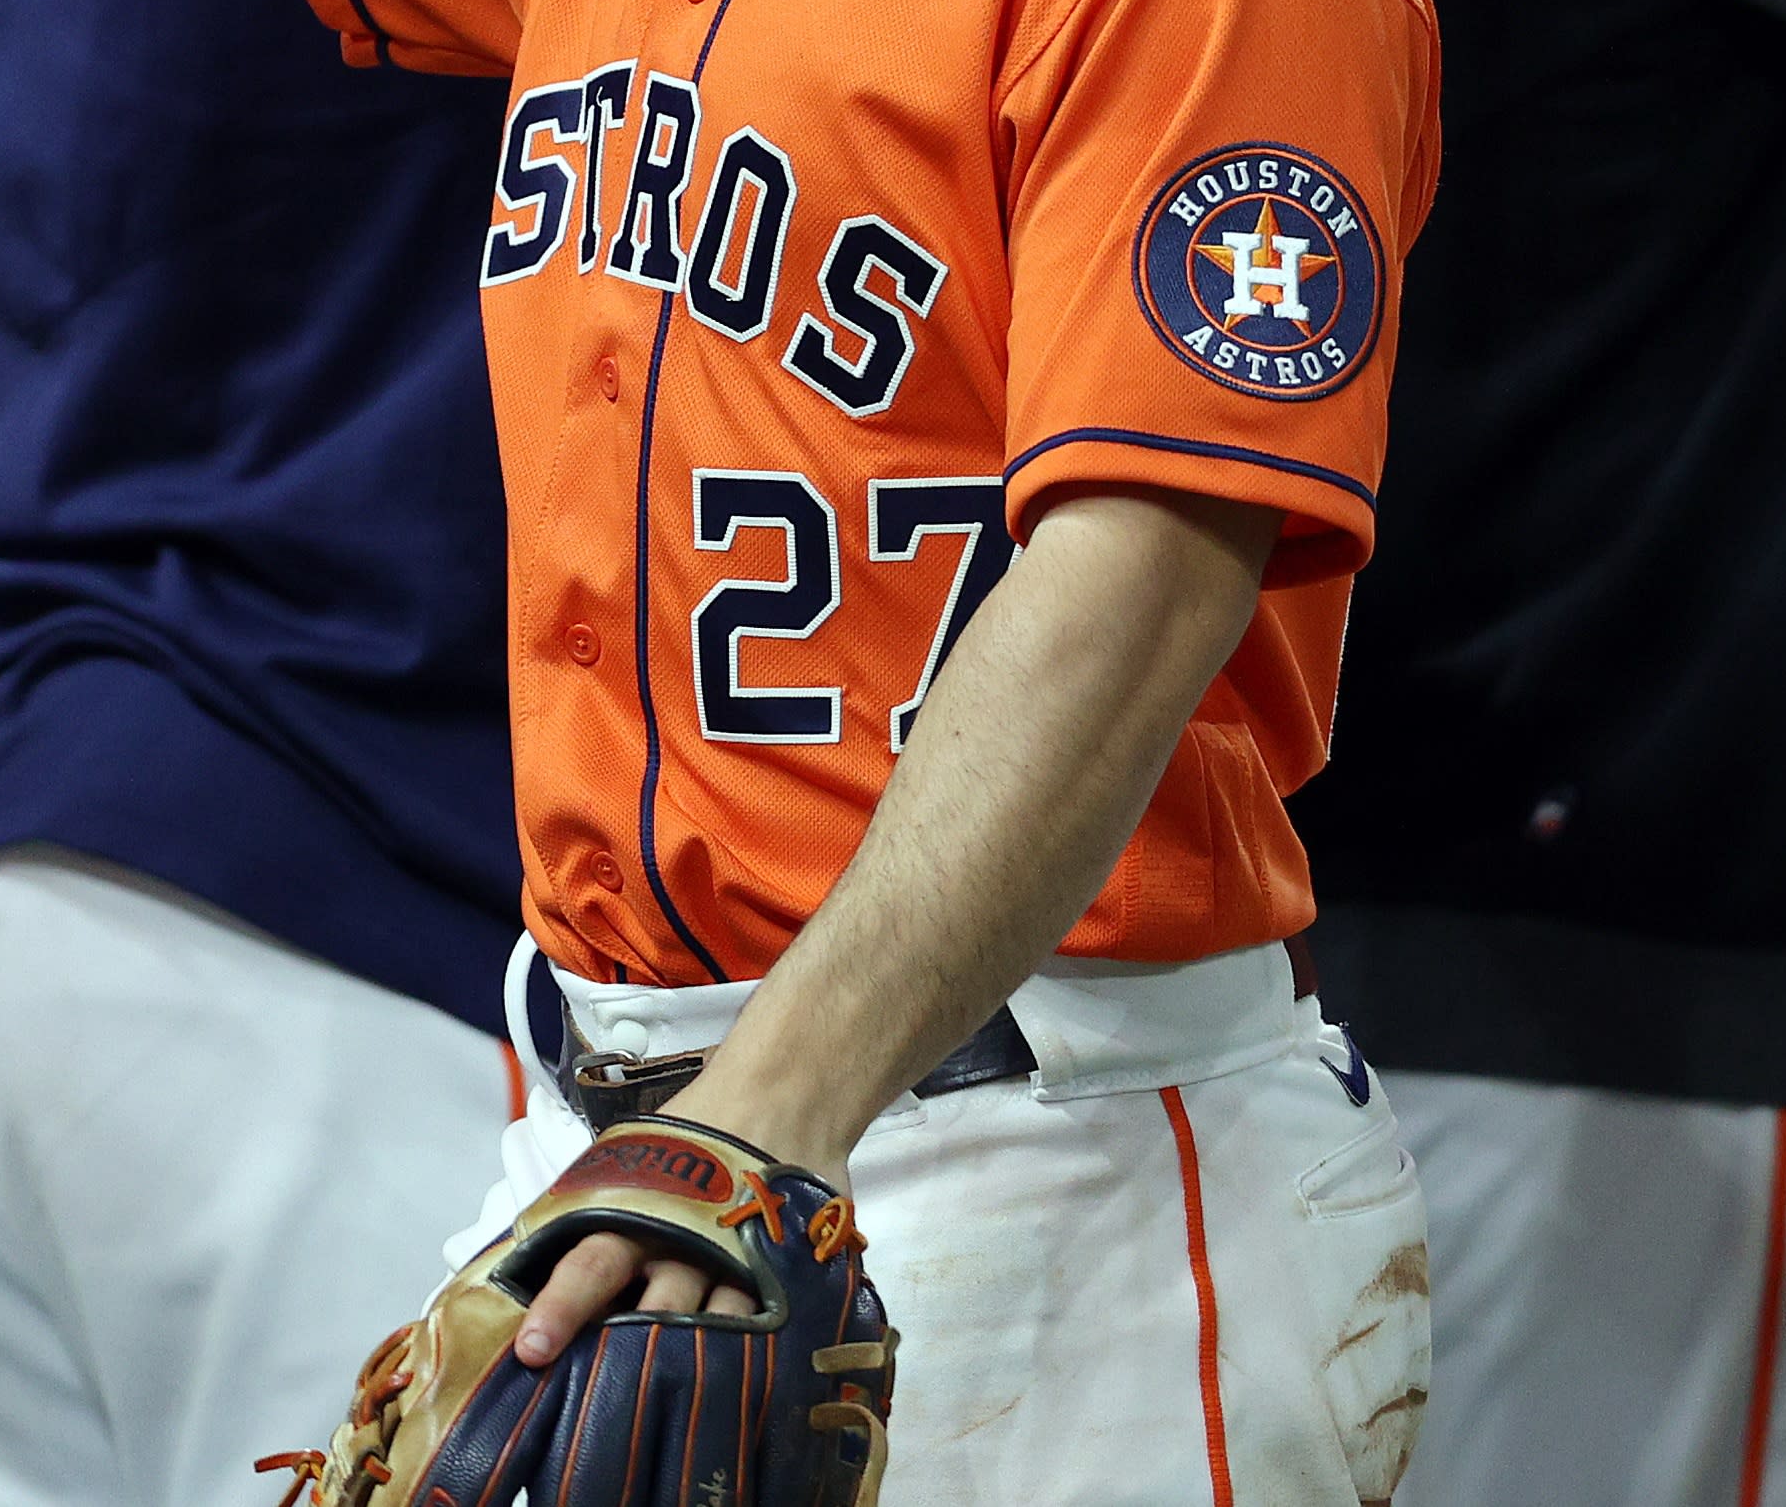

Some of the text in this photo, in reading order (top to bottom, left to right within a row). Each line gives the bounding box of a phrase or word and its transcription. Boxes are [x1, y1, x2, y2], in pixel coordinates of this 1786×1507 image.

[479, 57, 949, 418] STROS
[1168, 159, 1359, 240] HOUSTON
[1221, 231, 1311, 322] H
[1182, 324, 1348, 385] ASTROS
[691, 467, 1025, 754] 27
